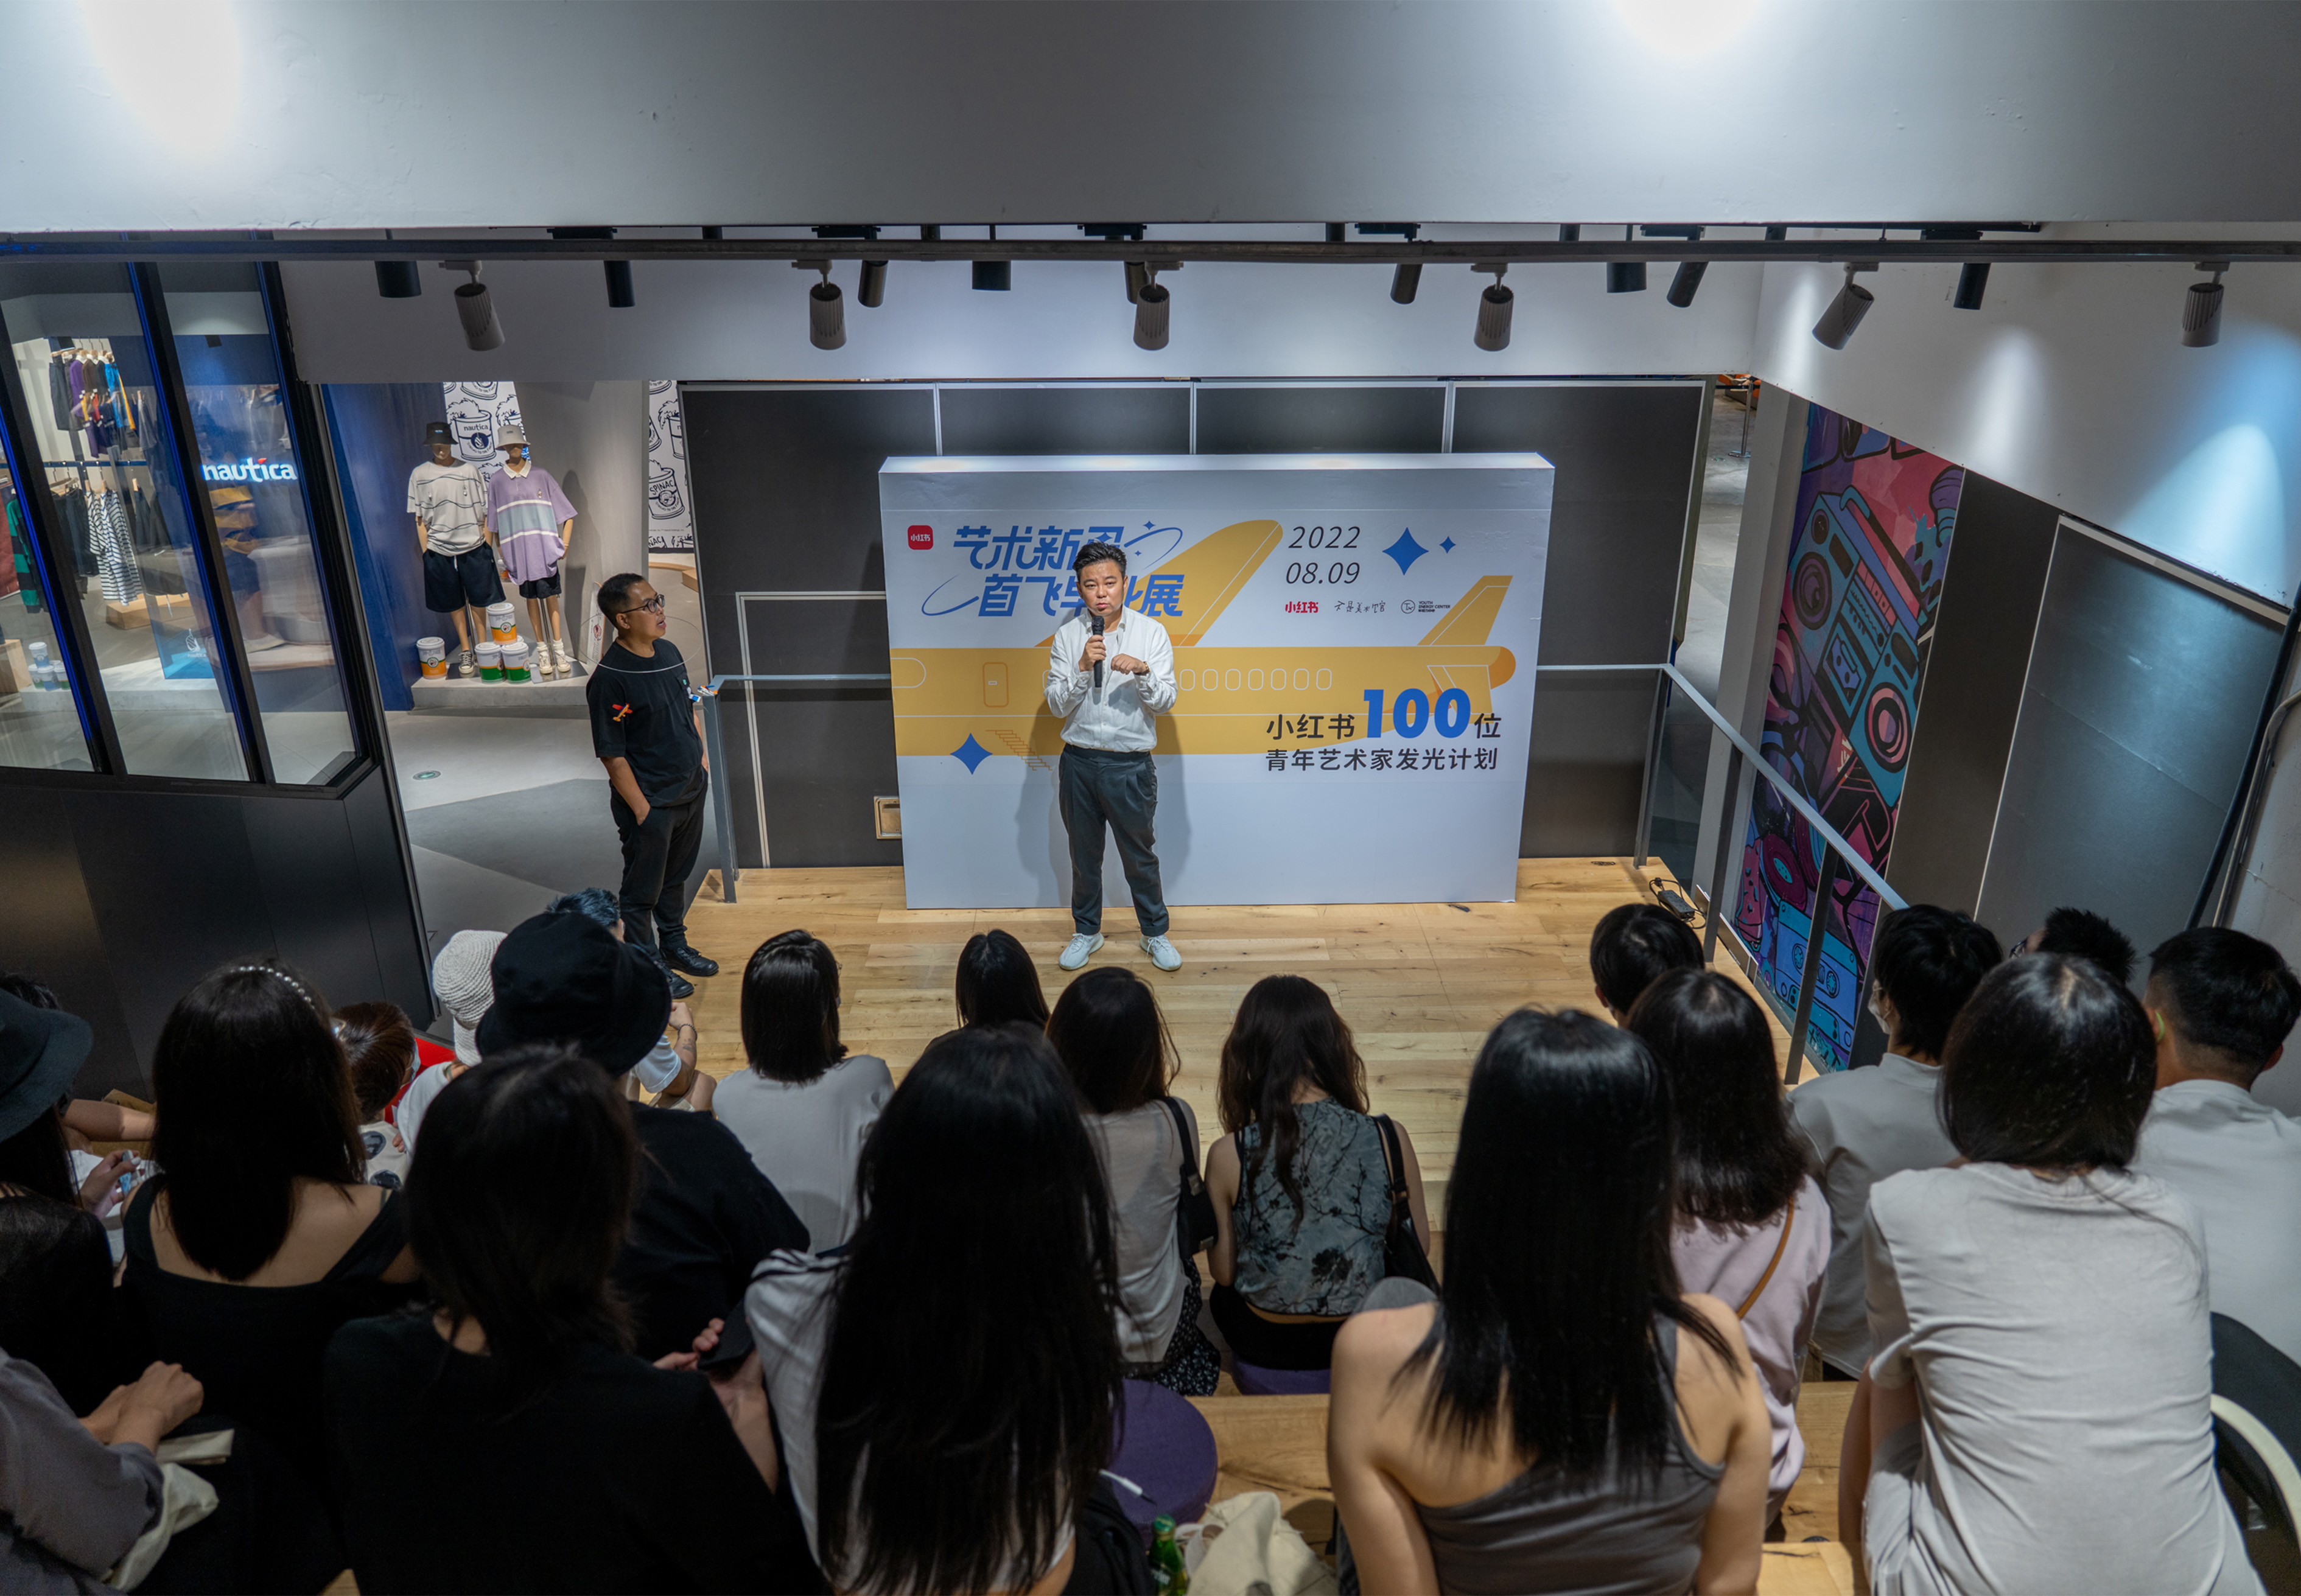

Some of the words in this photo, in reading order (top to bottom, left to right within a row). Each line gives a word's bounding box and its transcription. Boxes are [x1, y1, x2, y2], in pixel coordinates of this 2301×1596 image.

[201, 457, 298, 482] nautica
[1288, 526, 1361, 548] 2022
[1286, 562, 1360, 584] 08.09
[1284, 601, 1319, 613] 小红书
[1266, 747, 1497, 771] 青年艺术家发光计划
